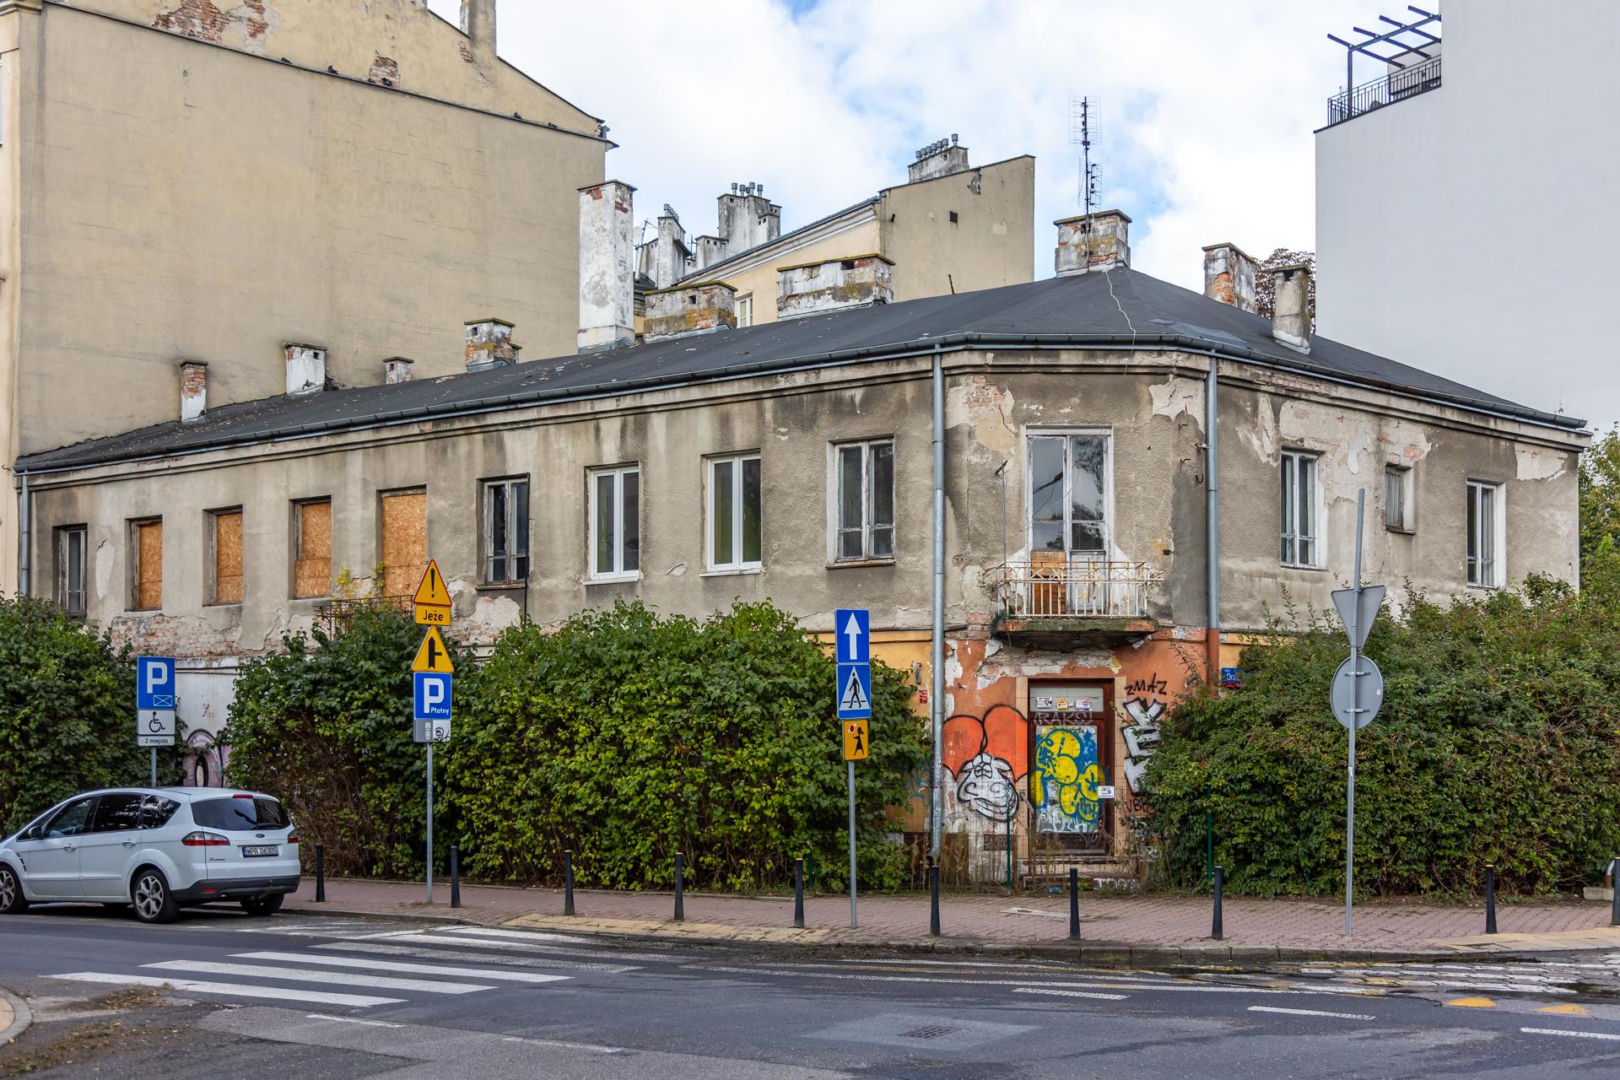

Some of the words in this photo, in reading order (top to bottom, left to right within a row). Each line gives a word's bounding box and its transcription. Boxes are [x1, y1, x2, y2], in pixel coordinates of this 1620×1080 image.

[423, 610, 444, 621] Jeże
[146, 661, 168, 694] P
[423, 678, 444, 714] P
